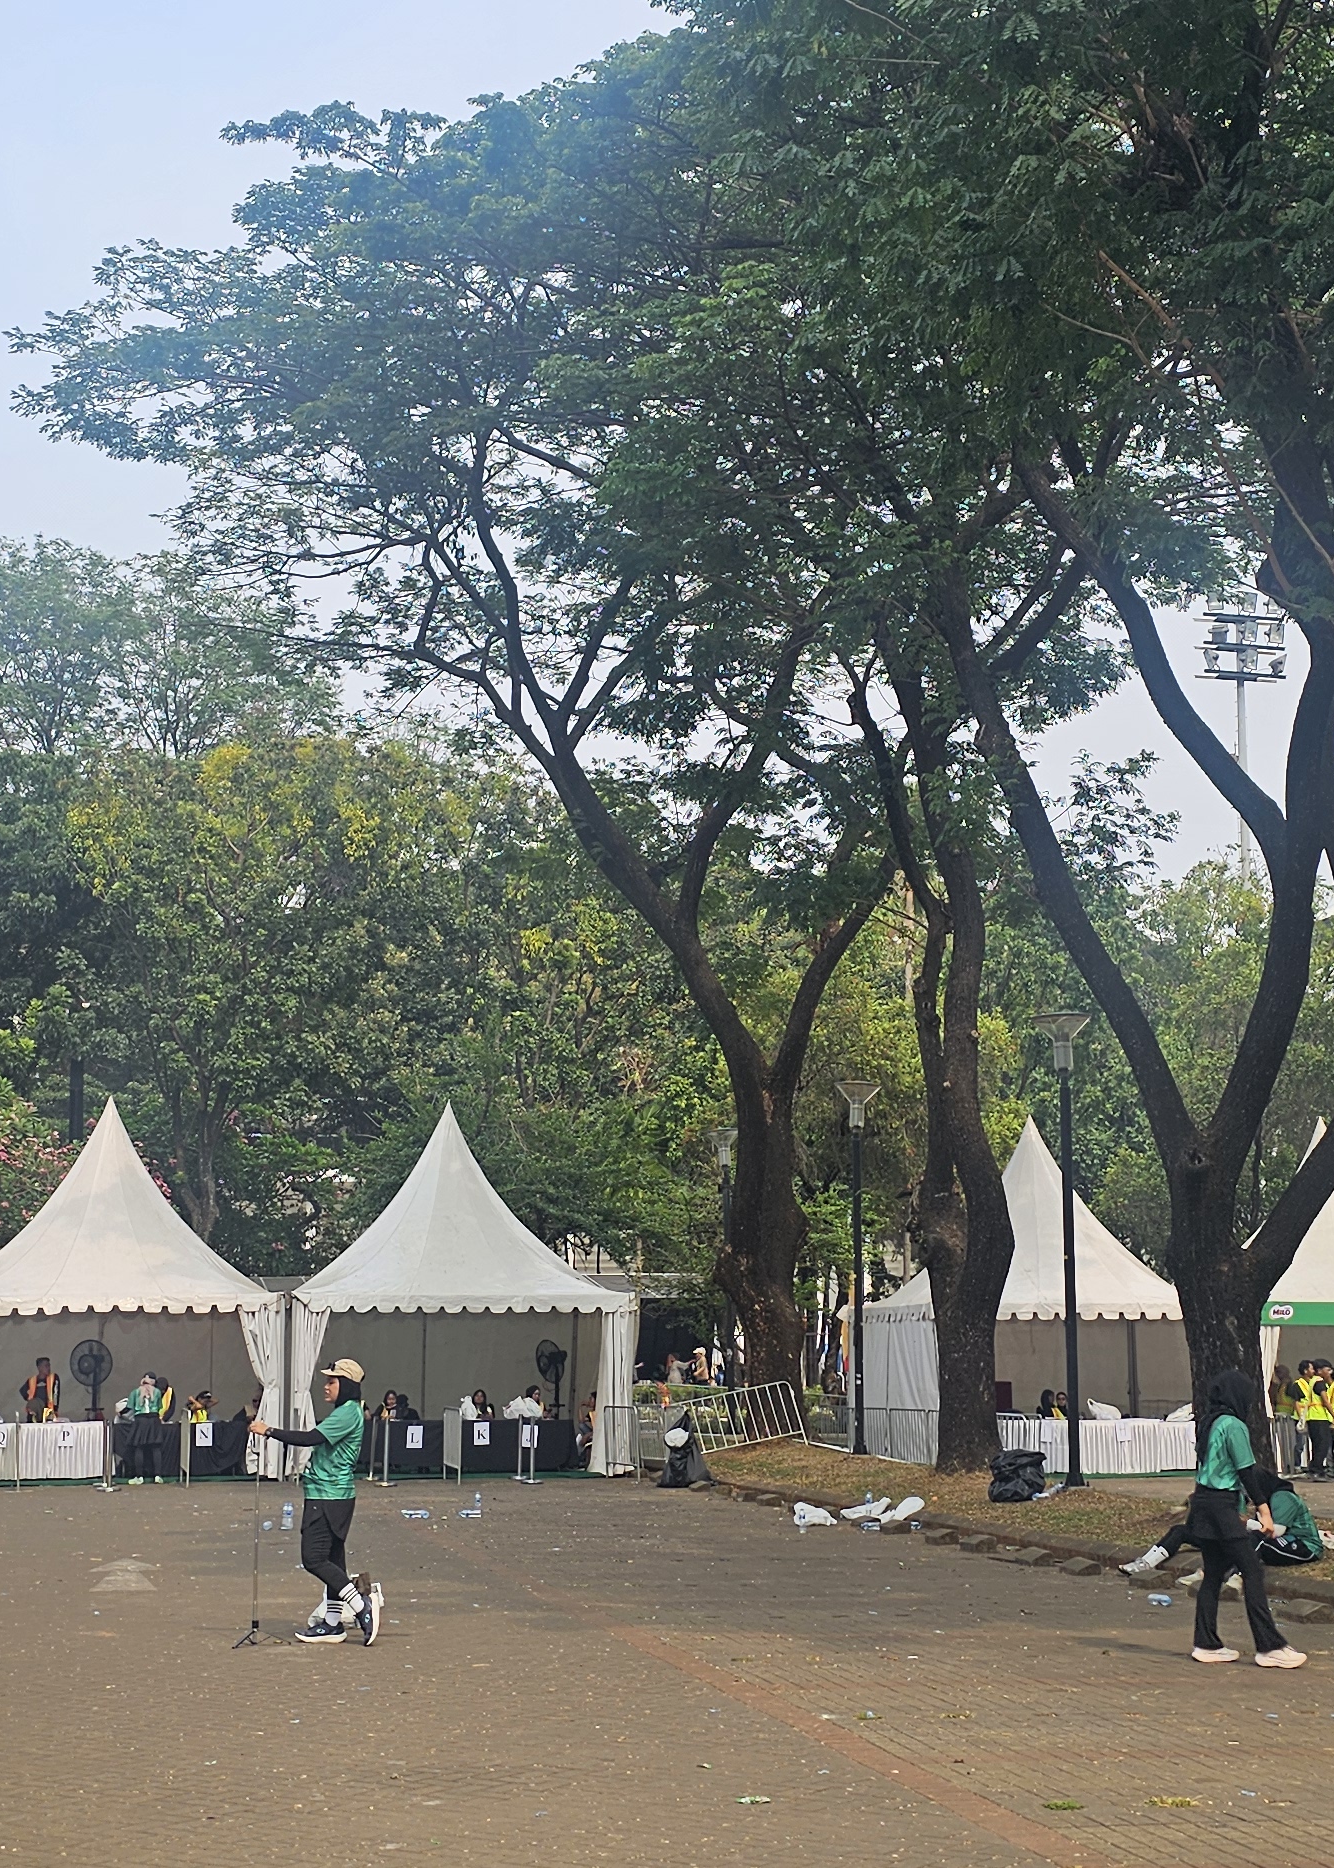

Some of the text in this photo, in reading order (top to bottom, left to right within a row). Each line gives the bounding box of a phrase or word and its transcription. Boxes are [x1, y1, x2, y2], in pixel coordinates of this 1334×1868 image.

[61, 1430, 70, 1442] P
[199, 1427, 209, 1439] N
[410, 1432, 420, 1444] L
[477, 1429, 487, 1440] K
